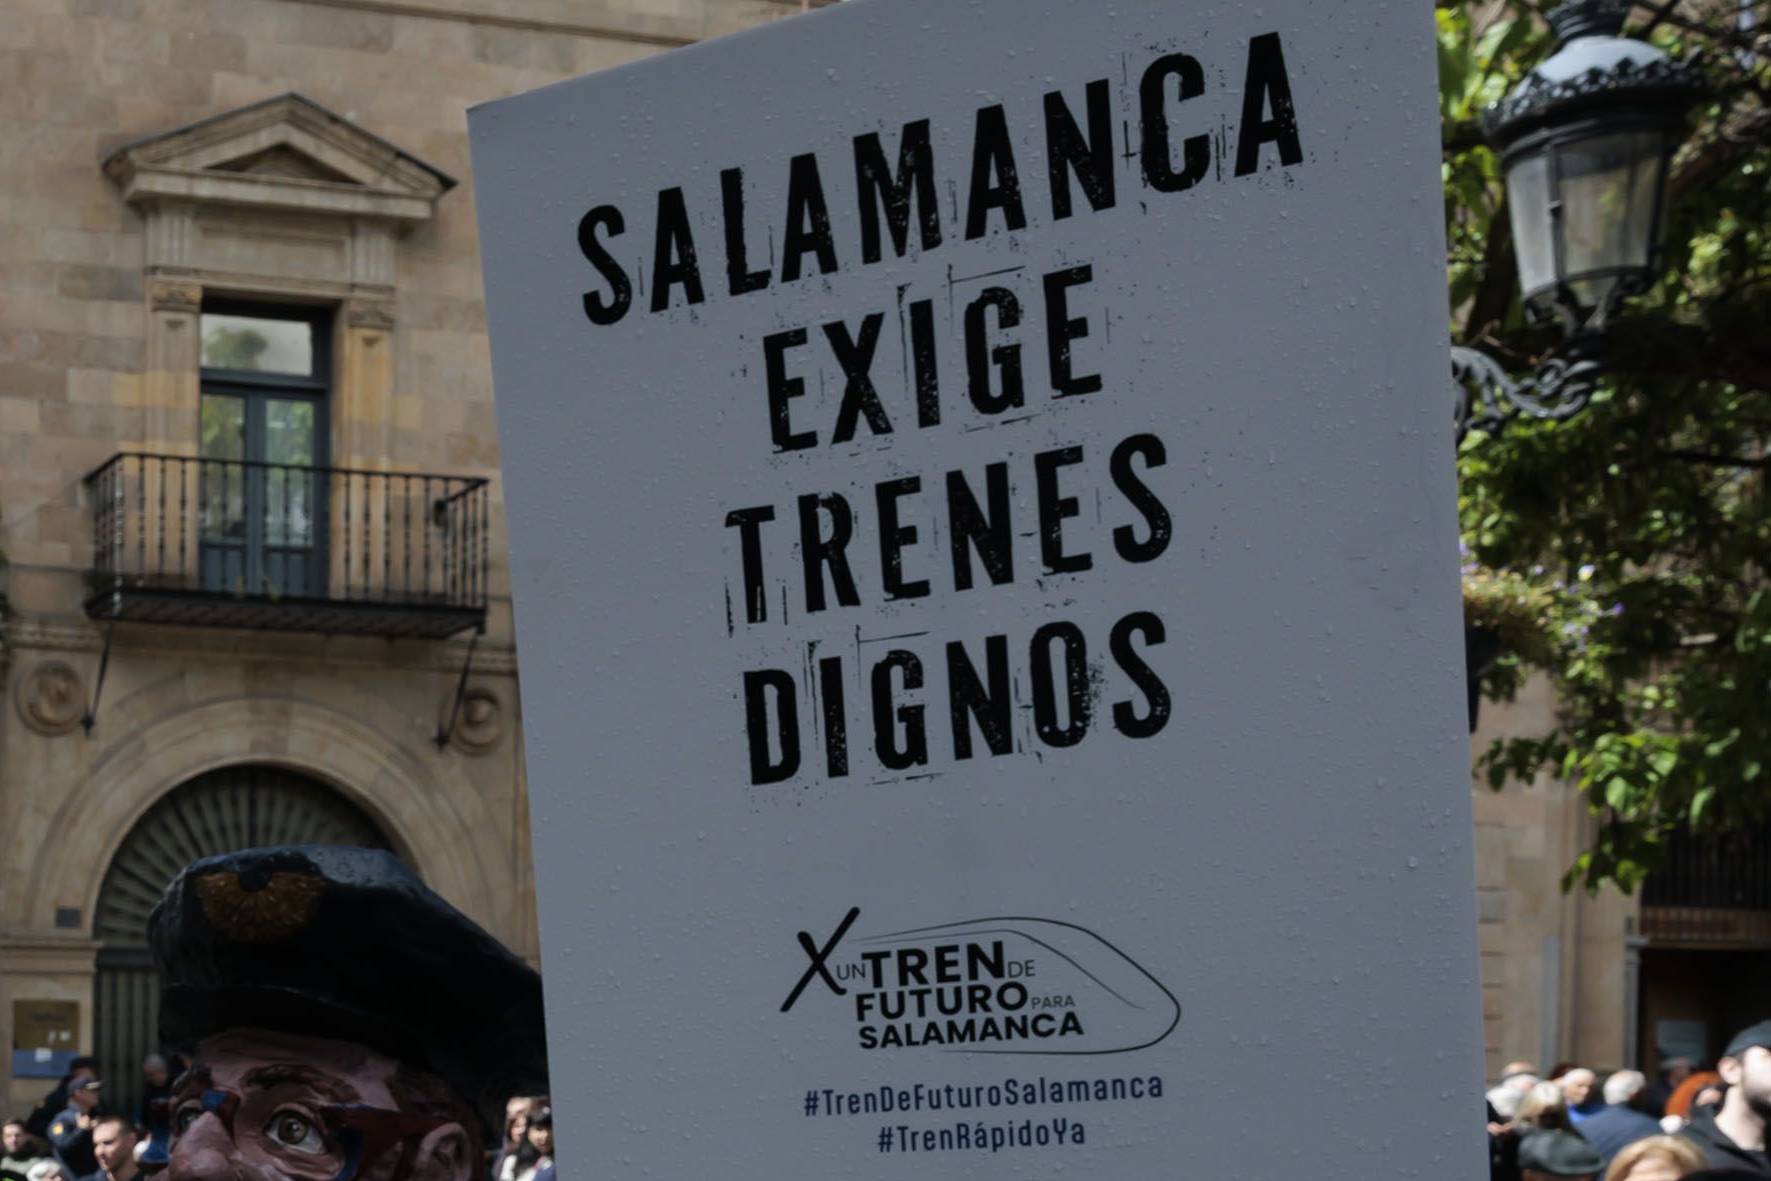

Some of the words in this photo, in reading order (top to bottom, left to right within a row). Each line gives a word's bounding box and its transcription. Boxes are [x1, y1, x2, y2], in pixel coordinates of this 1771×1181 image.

[577, 31, 1304, 327] SALAMANCA
[763, 264, 1104, 454] EXIGE
[724, 433, 1174, 630] TRENES
[743, 610, 1173, 787] DIGNOS
[780, 906, 860, 1012] X
[836, 963, 865, 980] UN
[861, 941, 1005, 989] TREN
[1007, 959, 1036, 978] DE
[855, 981, 1028, 1022] FUTURO
[1031, 995, 1076, 1009] PARA
[858, 1011, 1085, 1050] SALAMANCA
[803, 1075, 1164, 1118] #TrenDeFuturoSalamanca
[878, 1117, 1085, 1153] #TrenRápidoYa
